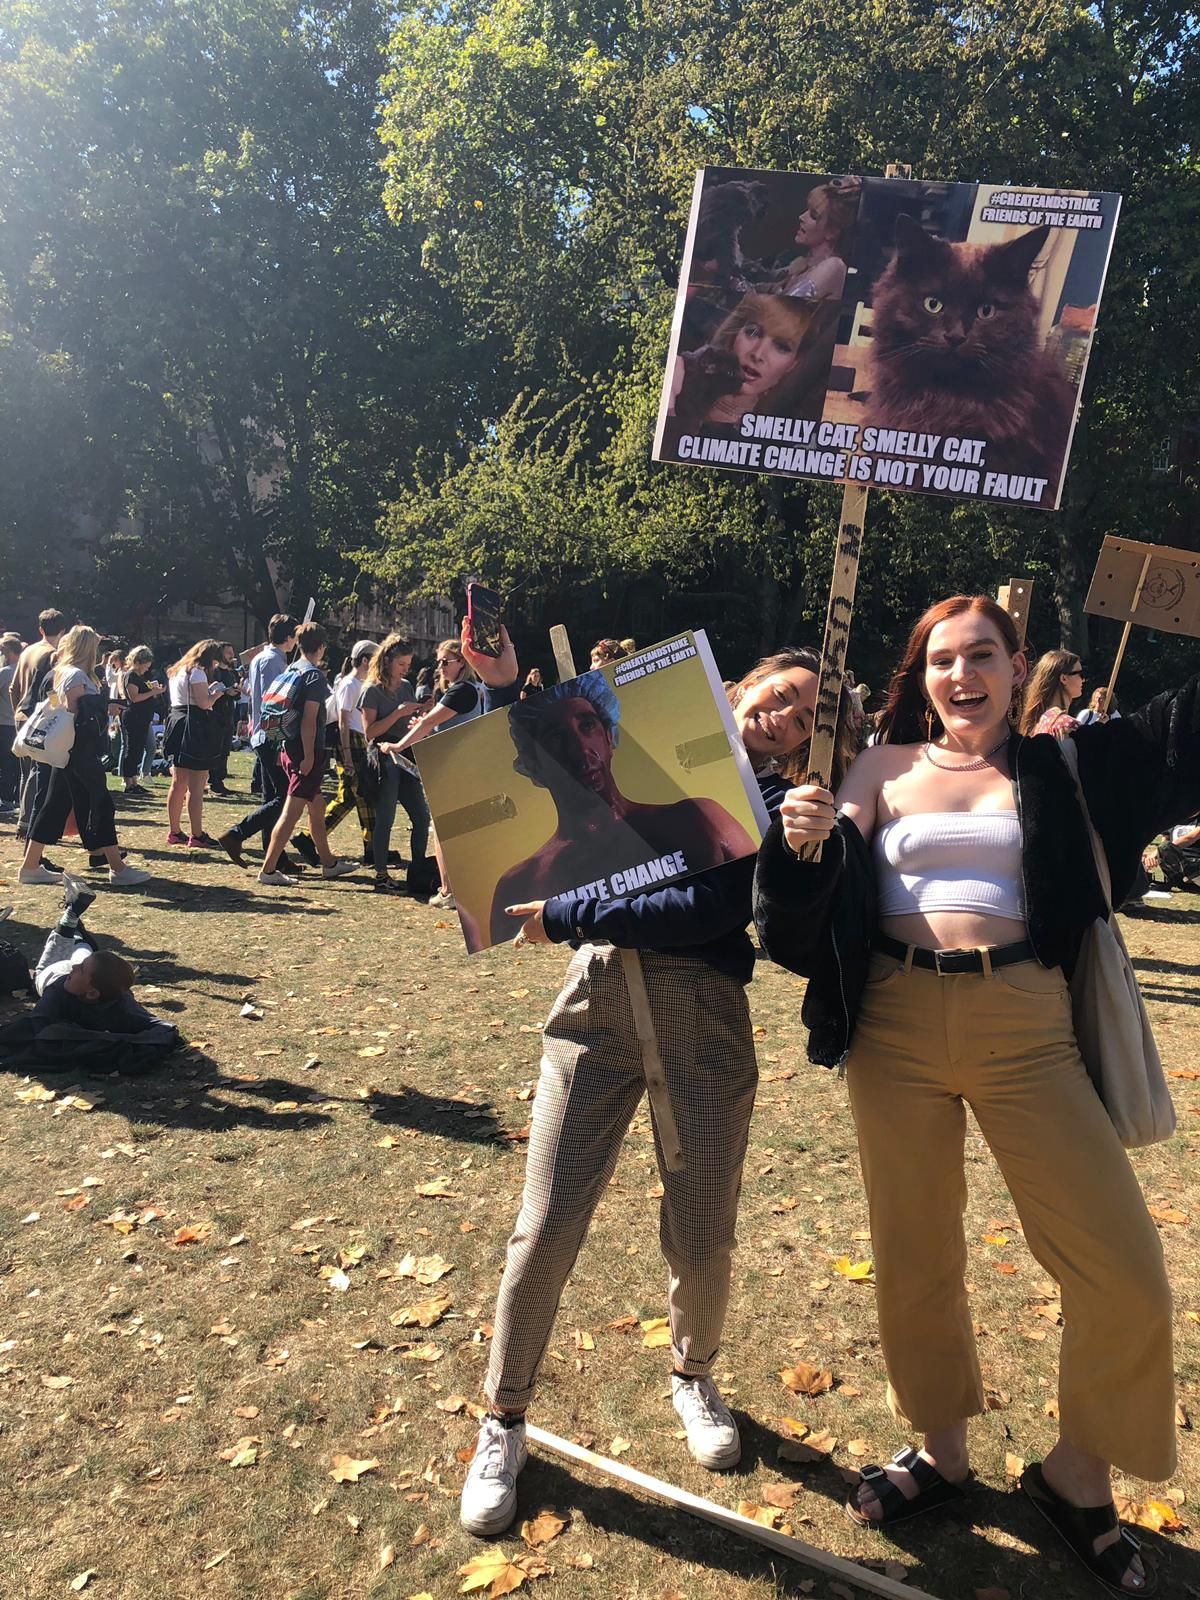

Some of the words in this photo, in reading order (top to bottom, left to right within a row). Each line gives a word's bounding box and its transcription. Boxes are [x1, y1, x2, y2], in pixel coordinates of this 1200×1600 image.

[982, 208, 1028, 223] FRIENDS
[1028, 211, 1044, 225] OF
[1044, 212, 1065, 226] THE
[1065, 213, 1103, 229] EARTH
[991, 192, 1101, 211] #CREATEANDSTRIKE
[740, 413, 817, 444] SMELLY
[817, 422, 859, 451] CAT,
[862, 427, 942, 459] SMELLY
[942, 437, 987, 468] CAT,
[677, 434, 763, 467] CLIMATE
[763, 445, 846, 477] CHANGE
[848, 455, 873, 482] IS
[874, 458, 921, 487] NOT
[922, 463, 980, 494] YOUR
[982, 471, 1049, 502] FAULT
[614, 666, 647, 687] FRIENDS
[645, 663, 658, 674] OF
[656, 656, 672, 669] THE
[671, 646, 697, 664] EARTH
[615, 637, 690, 675] #CREATEANDSTRIKE
[610, 850, 689, 896] CHANGE
